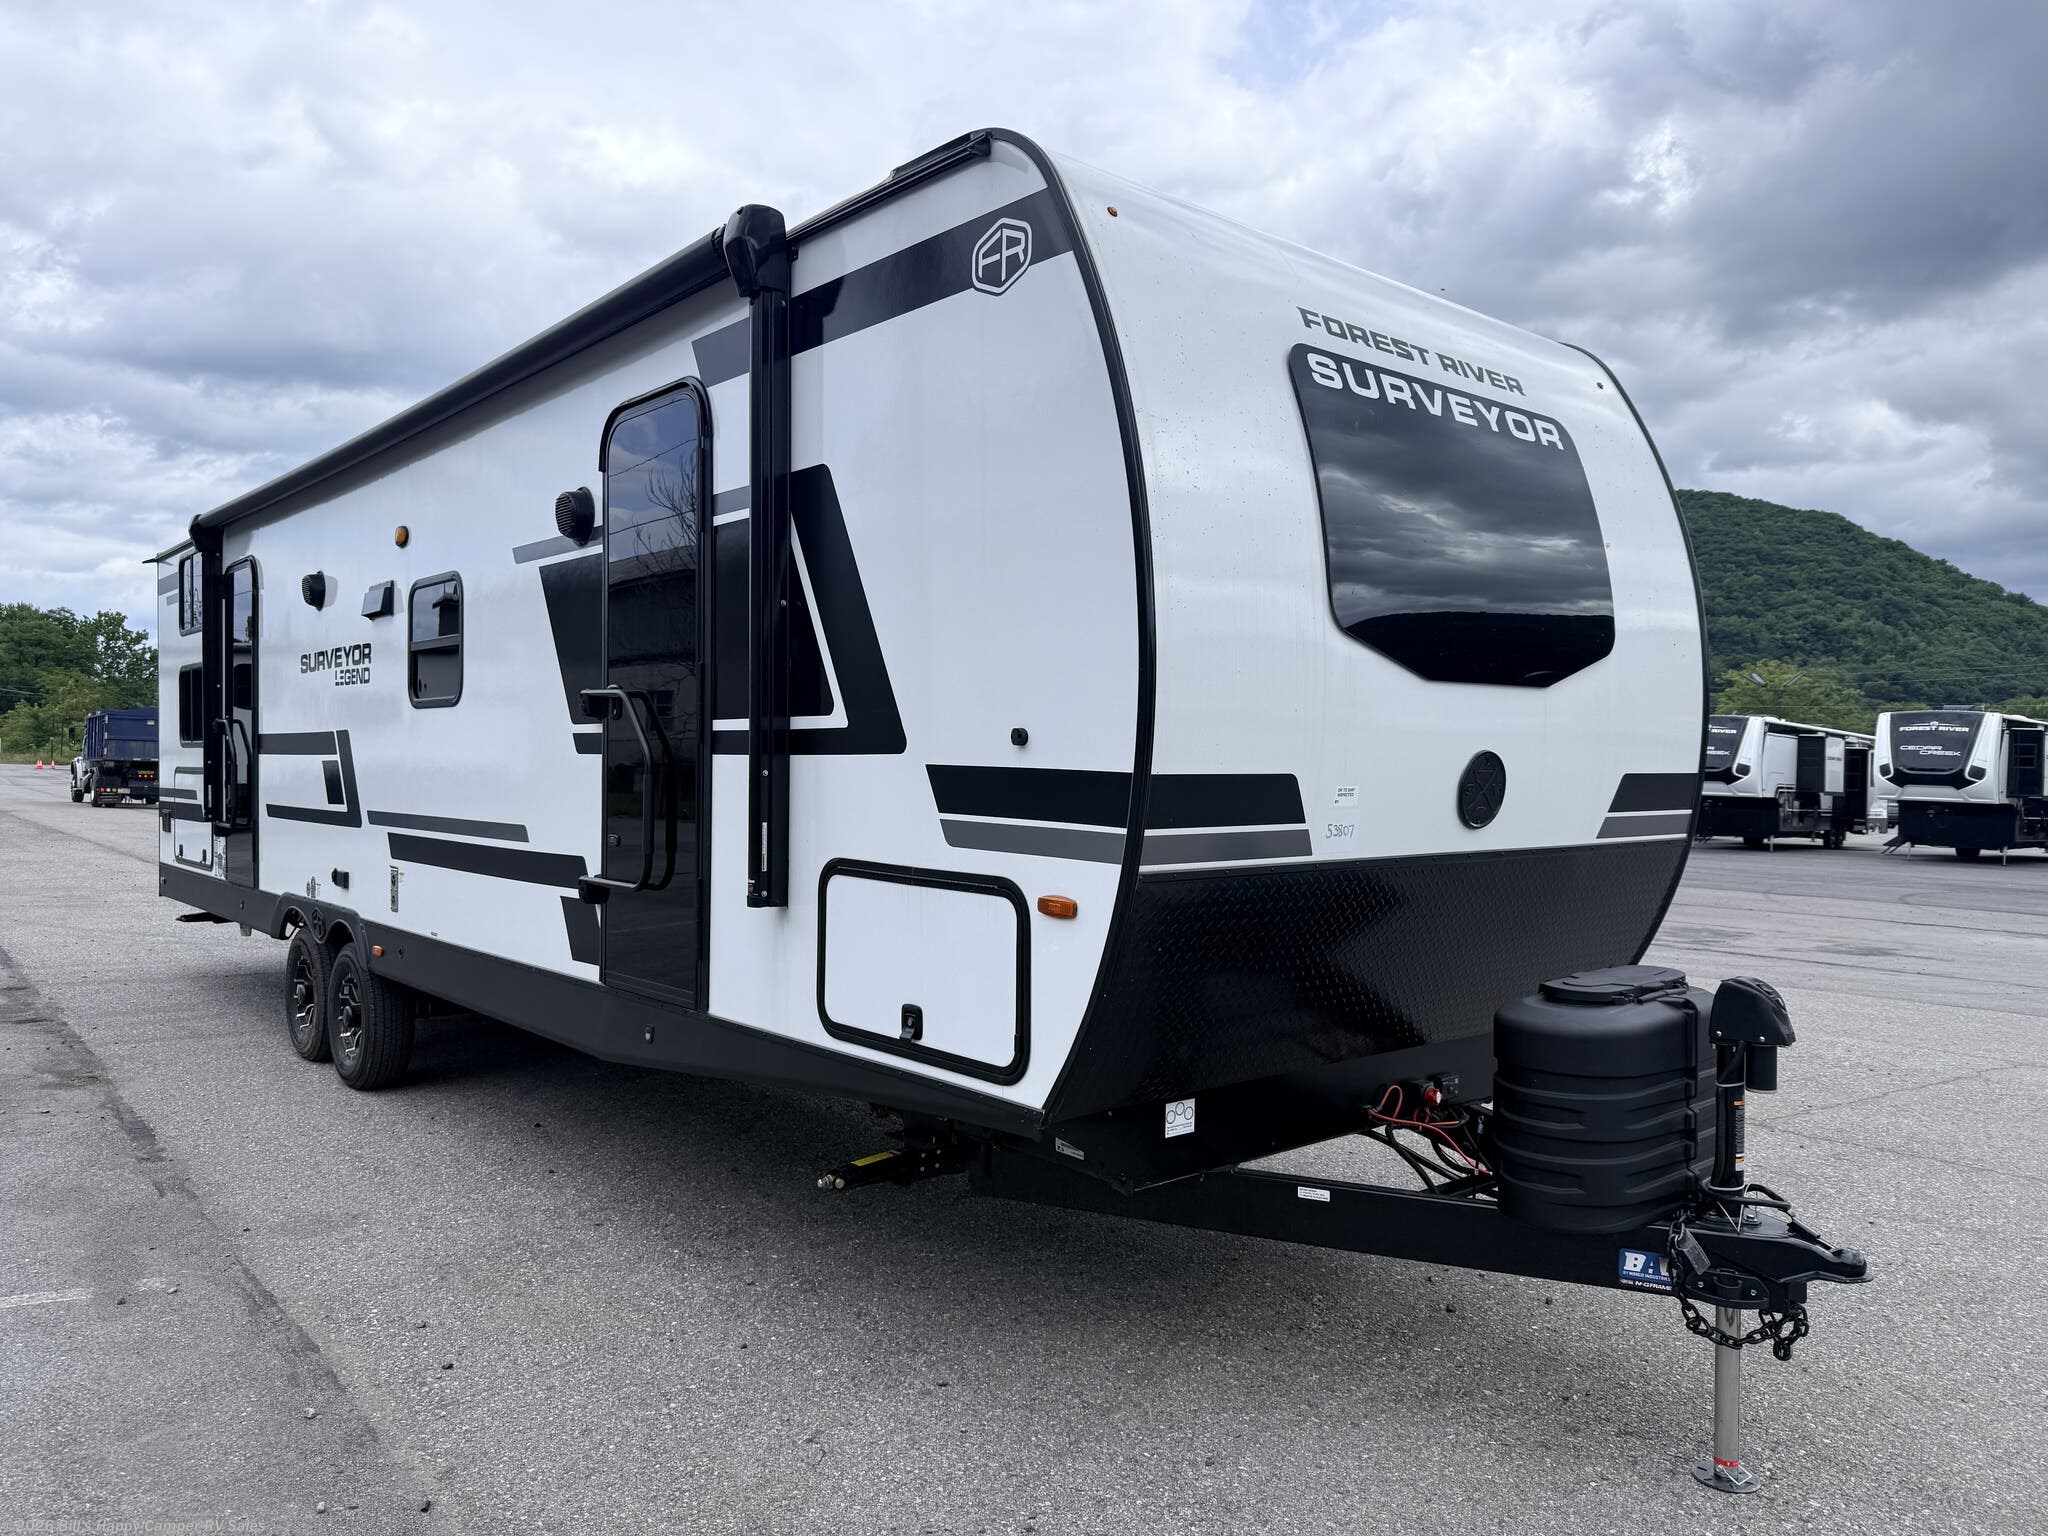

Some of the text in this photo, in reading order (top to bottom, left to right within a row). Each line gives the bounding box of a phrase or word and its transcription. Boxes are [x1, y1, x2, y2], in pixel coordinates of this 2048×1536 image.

[1296, 306, 1527, 397] FOREST RIVER
[1305, 352, 1565, 451] SURVEYOR
[300, 643, 372, 674] SURVEYOR
[335, 667, 371, 687] LEGEND
